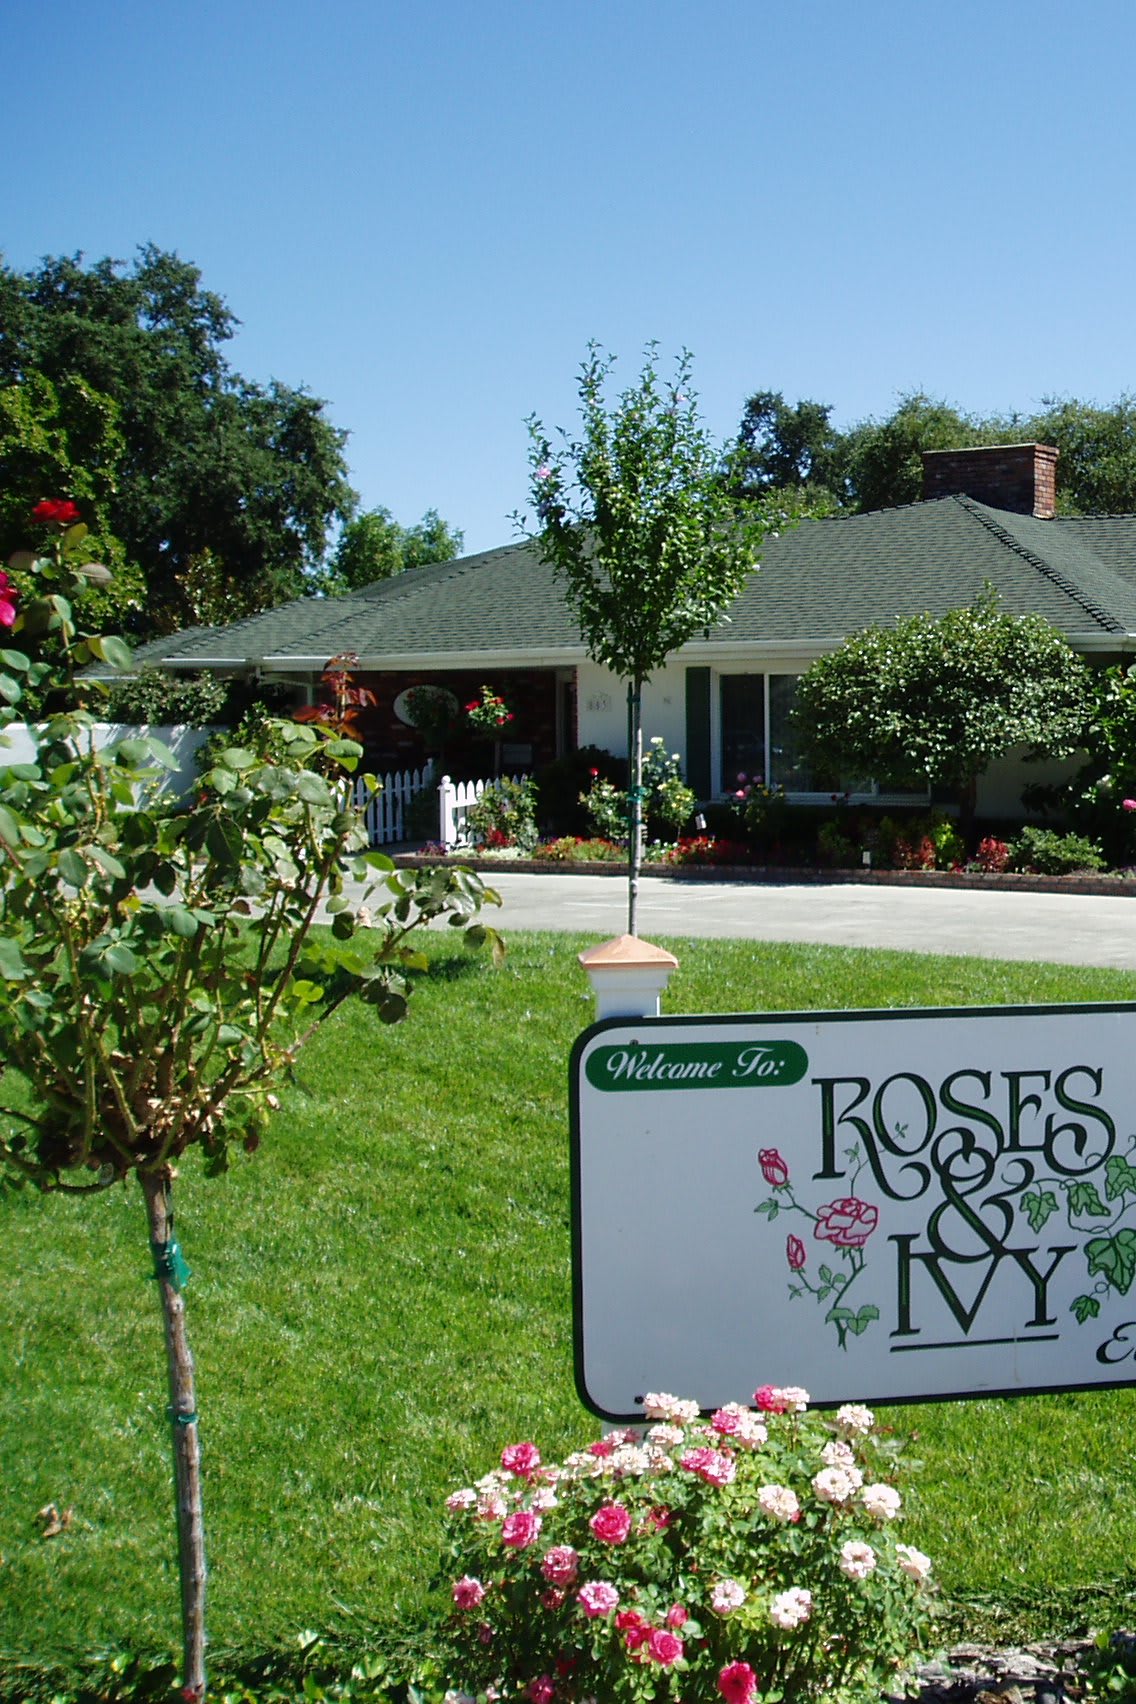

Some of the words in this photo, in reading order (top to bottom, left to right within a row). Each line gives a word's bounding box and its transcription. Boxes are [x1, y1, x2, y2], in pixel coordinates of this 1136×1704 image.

[606, 1049, 723, 1081] Welcome
[731, 1046, 786, 1078] To:
[811, 1065, 1116, 1201] ROSES
[927, 1147, 1035, 1264] &
[887, 1233, 1078, 1337] IVY
